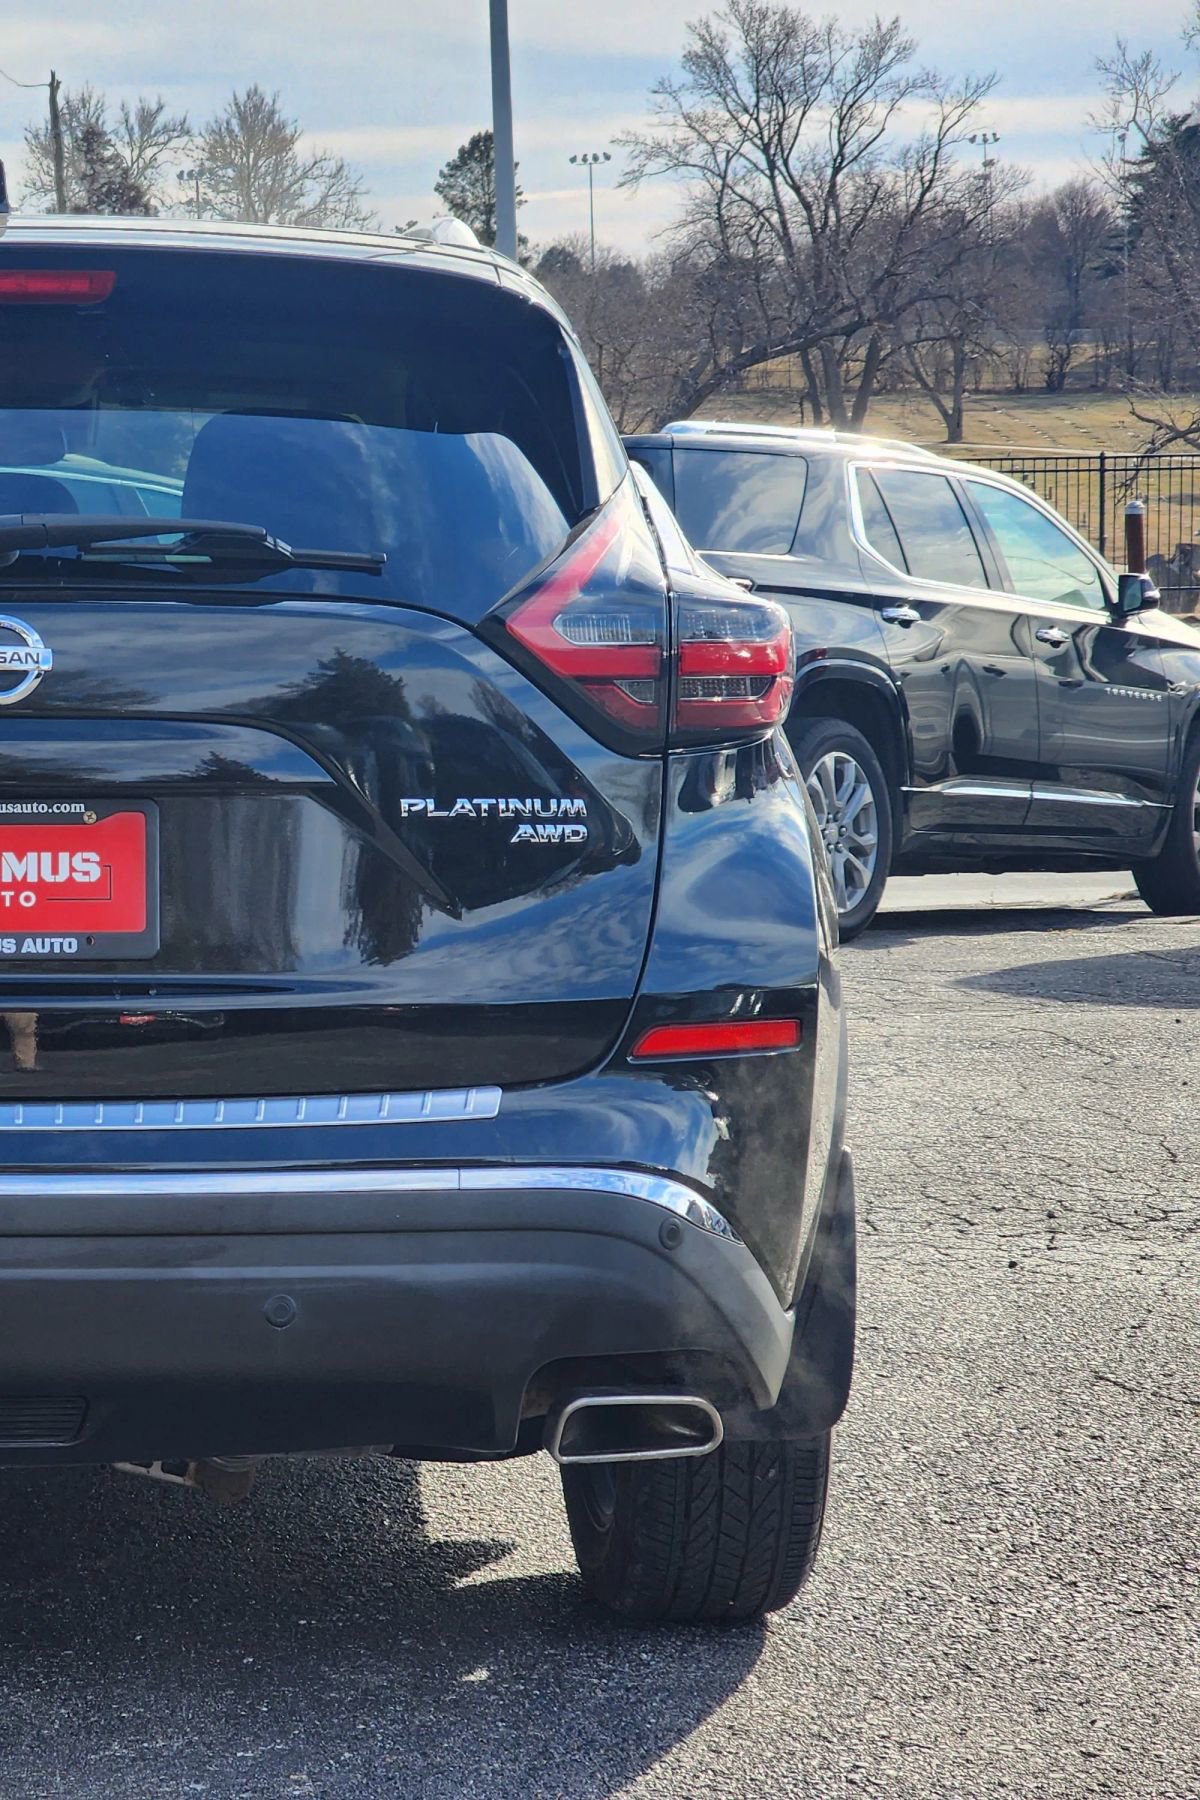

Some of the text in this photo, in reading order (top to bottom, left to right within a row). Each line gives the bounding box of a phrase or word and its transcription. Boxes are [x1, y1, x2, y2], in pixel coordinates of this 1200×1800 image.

[400, 798, 587, 817] PLATINUM
[510, 824, 588, 843] AWD
[21, 937, 78, 954] AUTO
